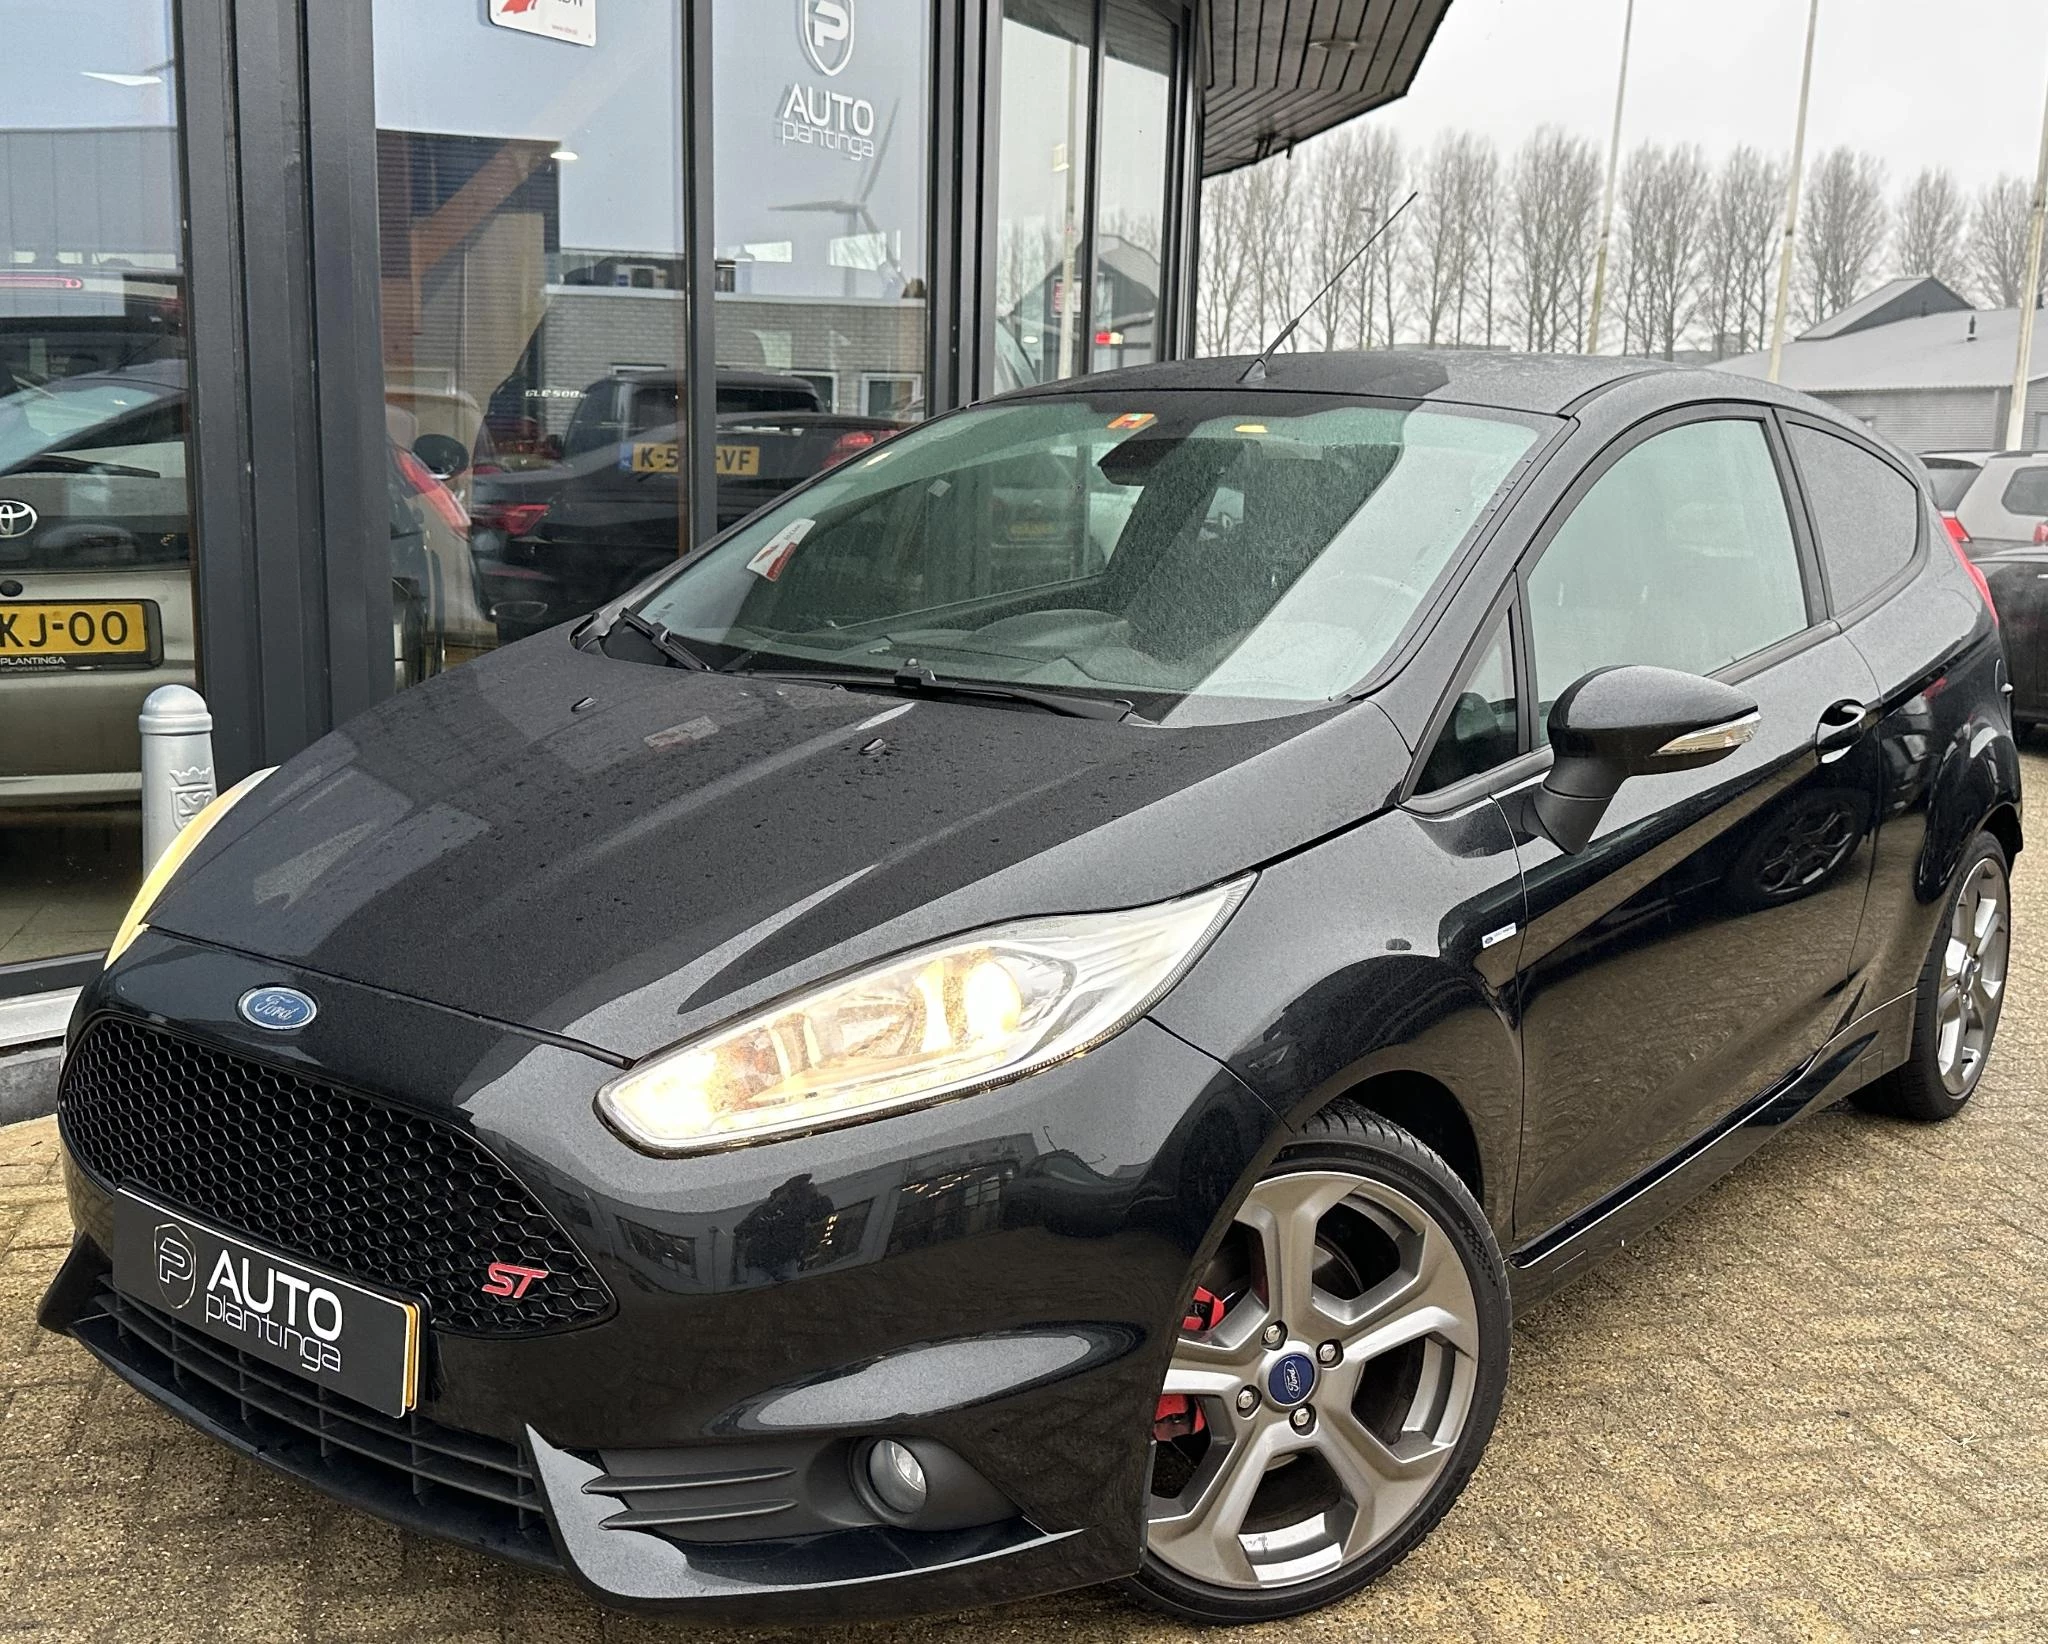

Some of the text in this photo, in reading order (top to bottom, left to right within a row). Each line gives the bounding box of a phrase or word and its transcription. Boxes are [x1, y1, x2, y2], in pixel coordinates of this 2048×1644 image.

[783, 83, 874, 137] AUTO
[782, 120, 874, 161] plantinga
[0, 611, 128, 647] KJ-00
[0, 656, 66, 665] PLANTINGA
[254, 994, 300, 1020] Ford
[207, 1250, 343, 1341] AUTO
[482, 1263, 549, 1298] ST
[206, 1293, 341, 1373] plantinga
[1286, 1367, 1300, 1392] Ford
